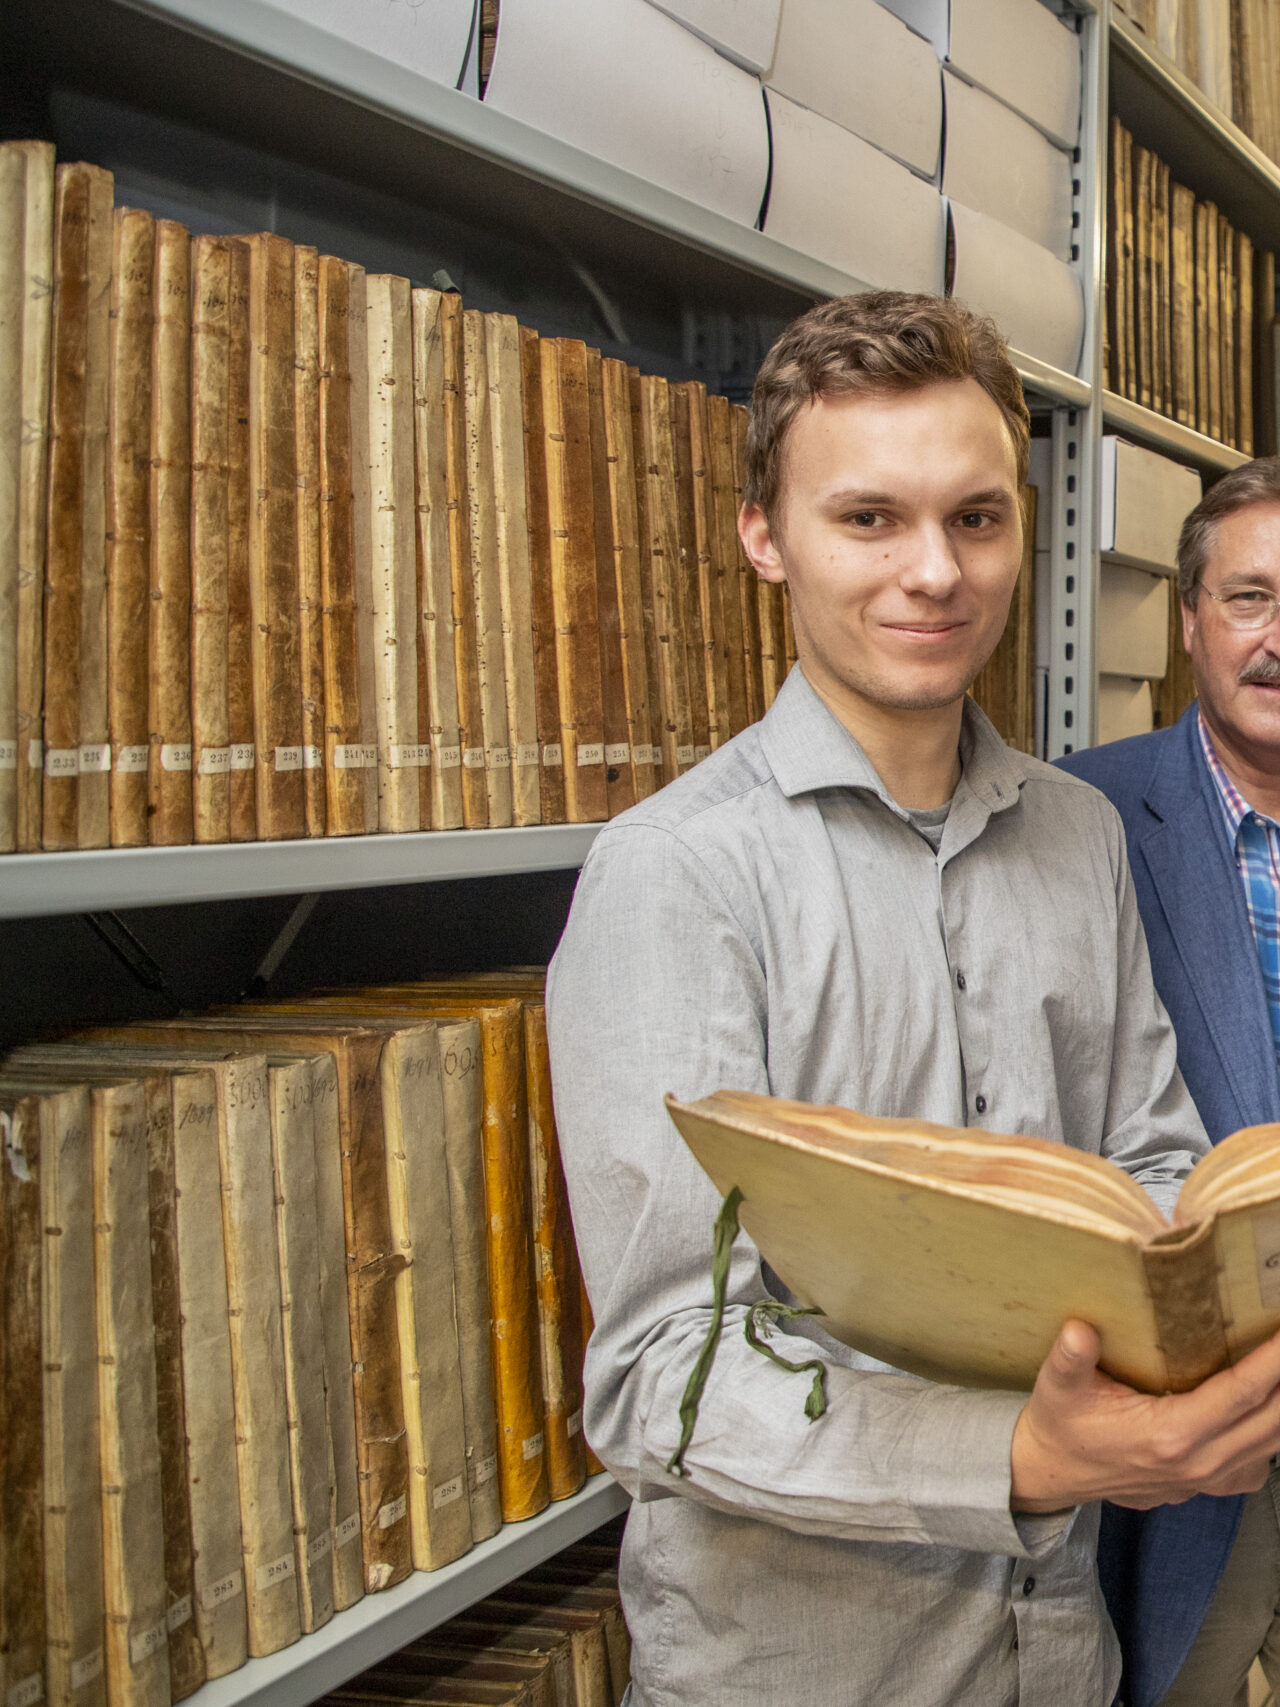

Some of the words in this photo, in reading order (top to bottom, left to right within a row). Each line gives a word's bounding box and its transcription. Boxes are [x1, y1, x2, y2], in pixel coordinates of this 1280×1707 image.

[210, 753, 228, 763] 237
[283, 751, 298, 761] 239
[585, 750, 599, 759] 250
[612, 750, 626, 759] 251
[441, 1483, 457, 1498] 288
[343, 1519, 357, 1534] 286
[268, 1560, 288, 1577] 284
[214, 1580, 233, 1597] 283
